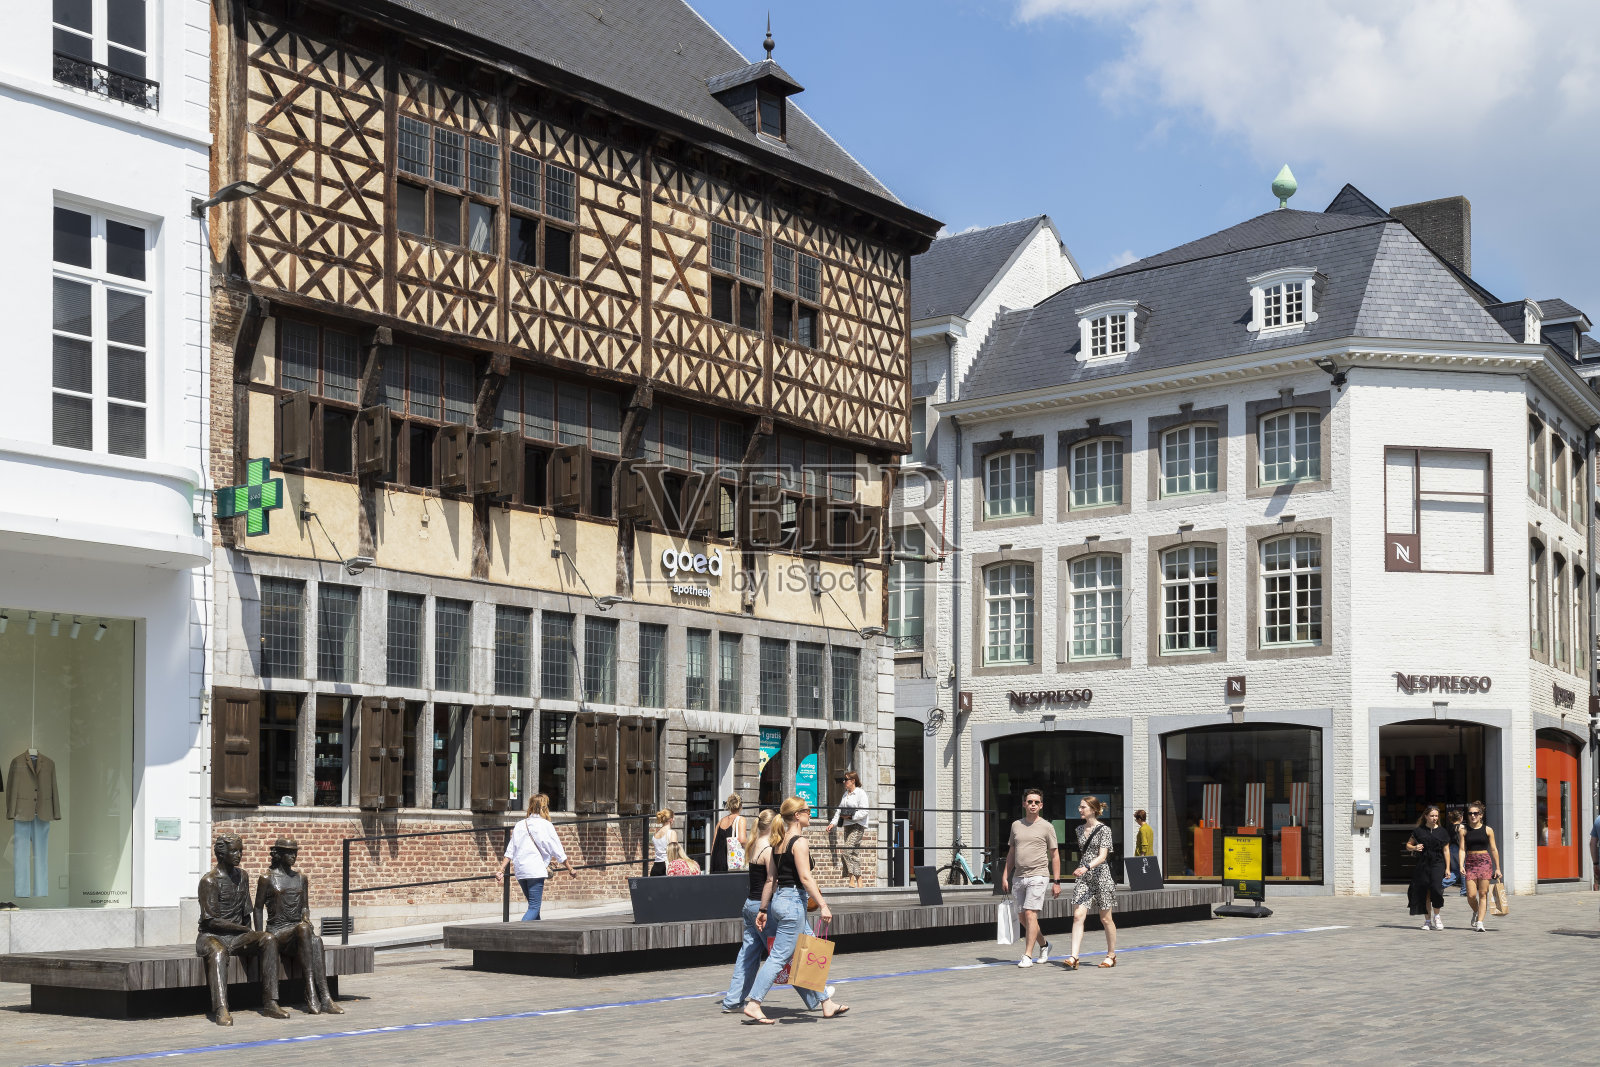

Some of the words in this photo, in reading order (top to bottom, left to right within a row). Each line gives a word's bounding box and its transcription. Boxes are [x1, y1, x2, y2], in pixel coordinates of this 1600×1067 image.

[1391, 541, 1416, 564] N
[662, 548, 723, 577] goed
[673, 584, 713, 598] apotheek
[1231, 679, 1243, 692] N
[1395, 671, 1492, 693] NESPRESSO
[1008, 688, 1093, 707] NESPRESSO
[766, 731, 782, 740] gratis
